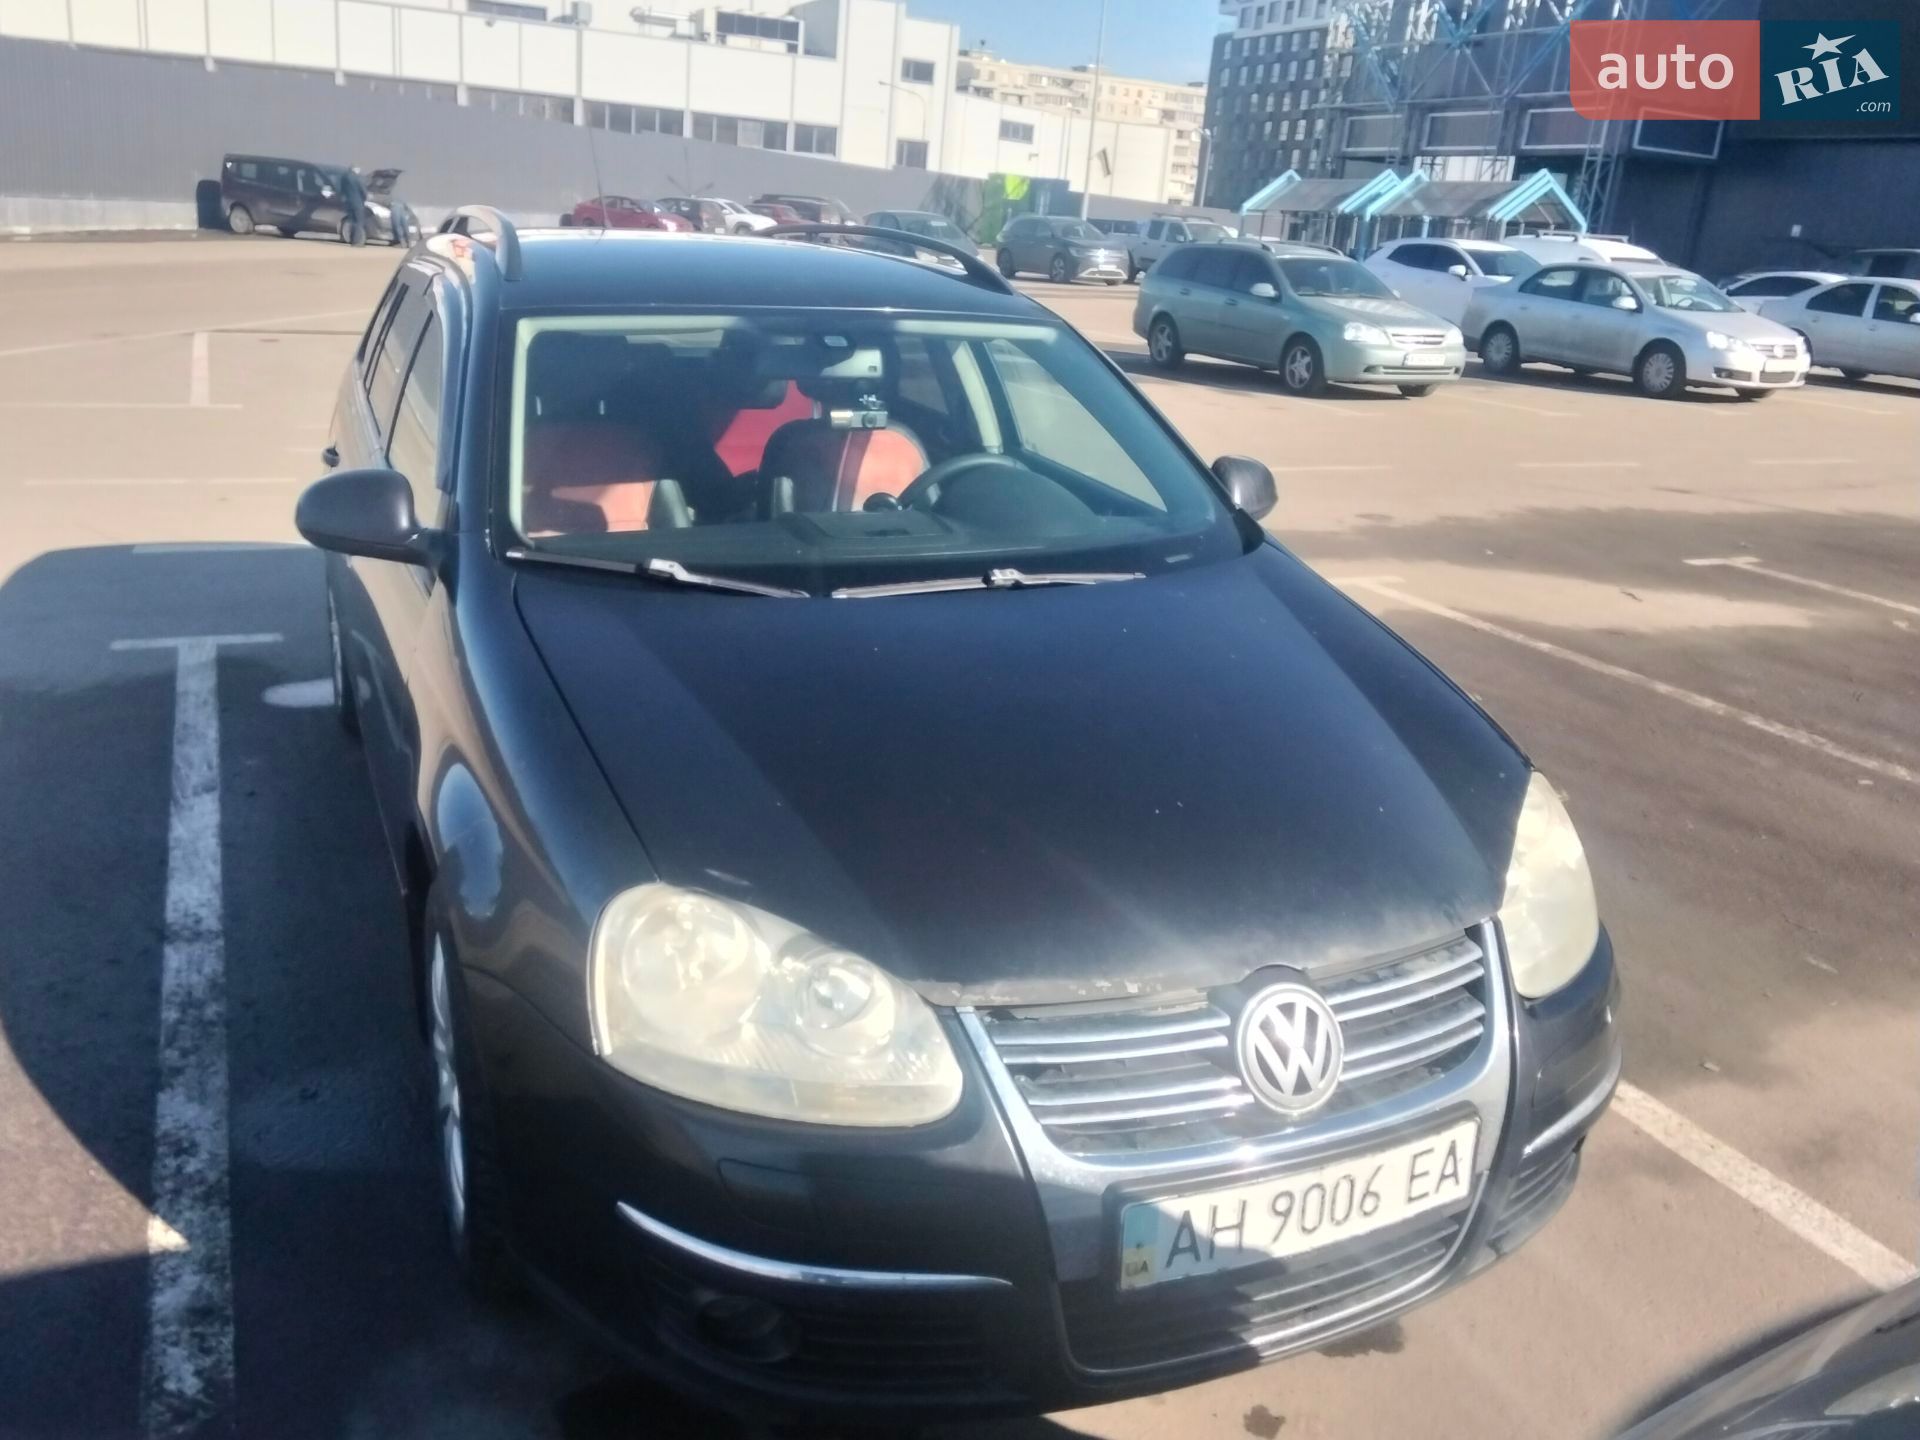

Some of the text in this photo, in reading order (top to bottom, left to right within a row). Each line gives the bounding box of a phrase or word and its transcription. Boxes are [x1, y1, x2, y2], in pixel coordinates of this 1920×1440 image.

[1165, 1140, 1462, 1268] AH 9006 EA
